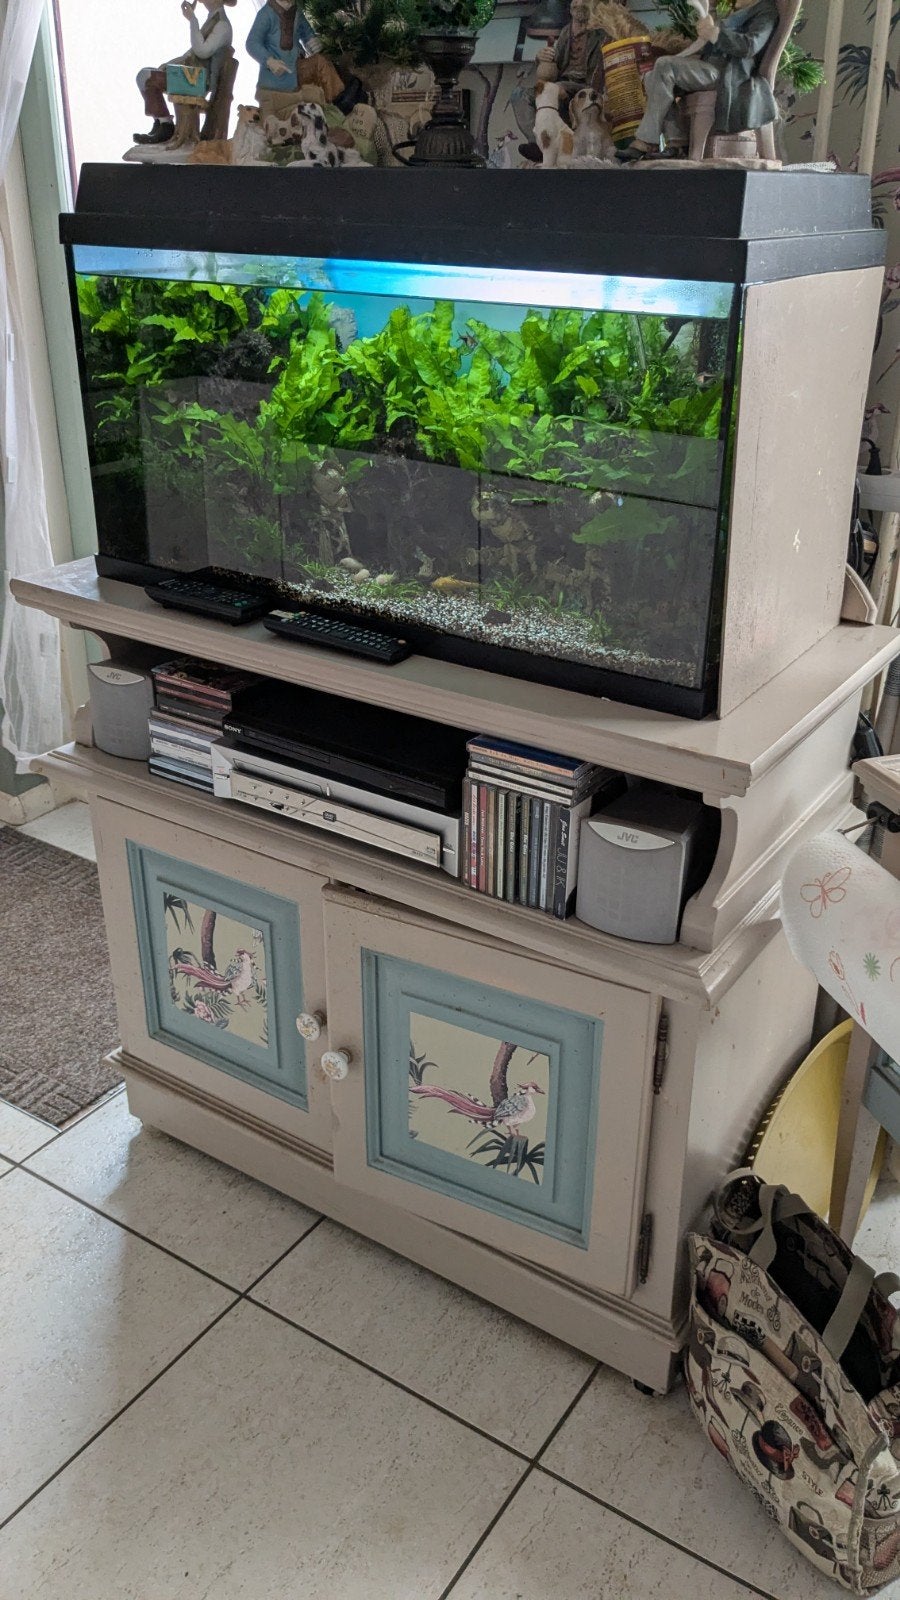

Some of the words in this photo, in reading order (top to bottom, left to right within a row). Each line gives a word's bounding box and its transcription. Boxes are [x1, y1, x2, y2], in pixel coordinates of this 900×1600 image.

[107, 672, 122, 681] JVC
[224, 724, 242, 734] SONY
[617, 831, 639, 843] JVC
[802, 1470, 824, 1498] STYLE
